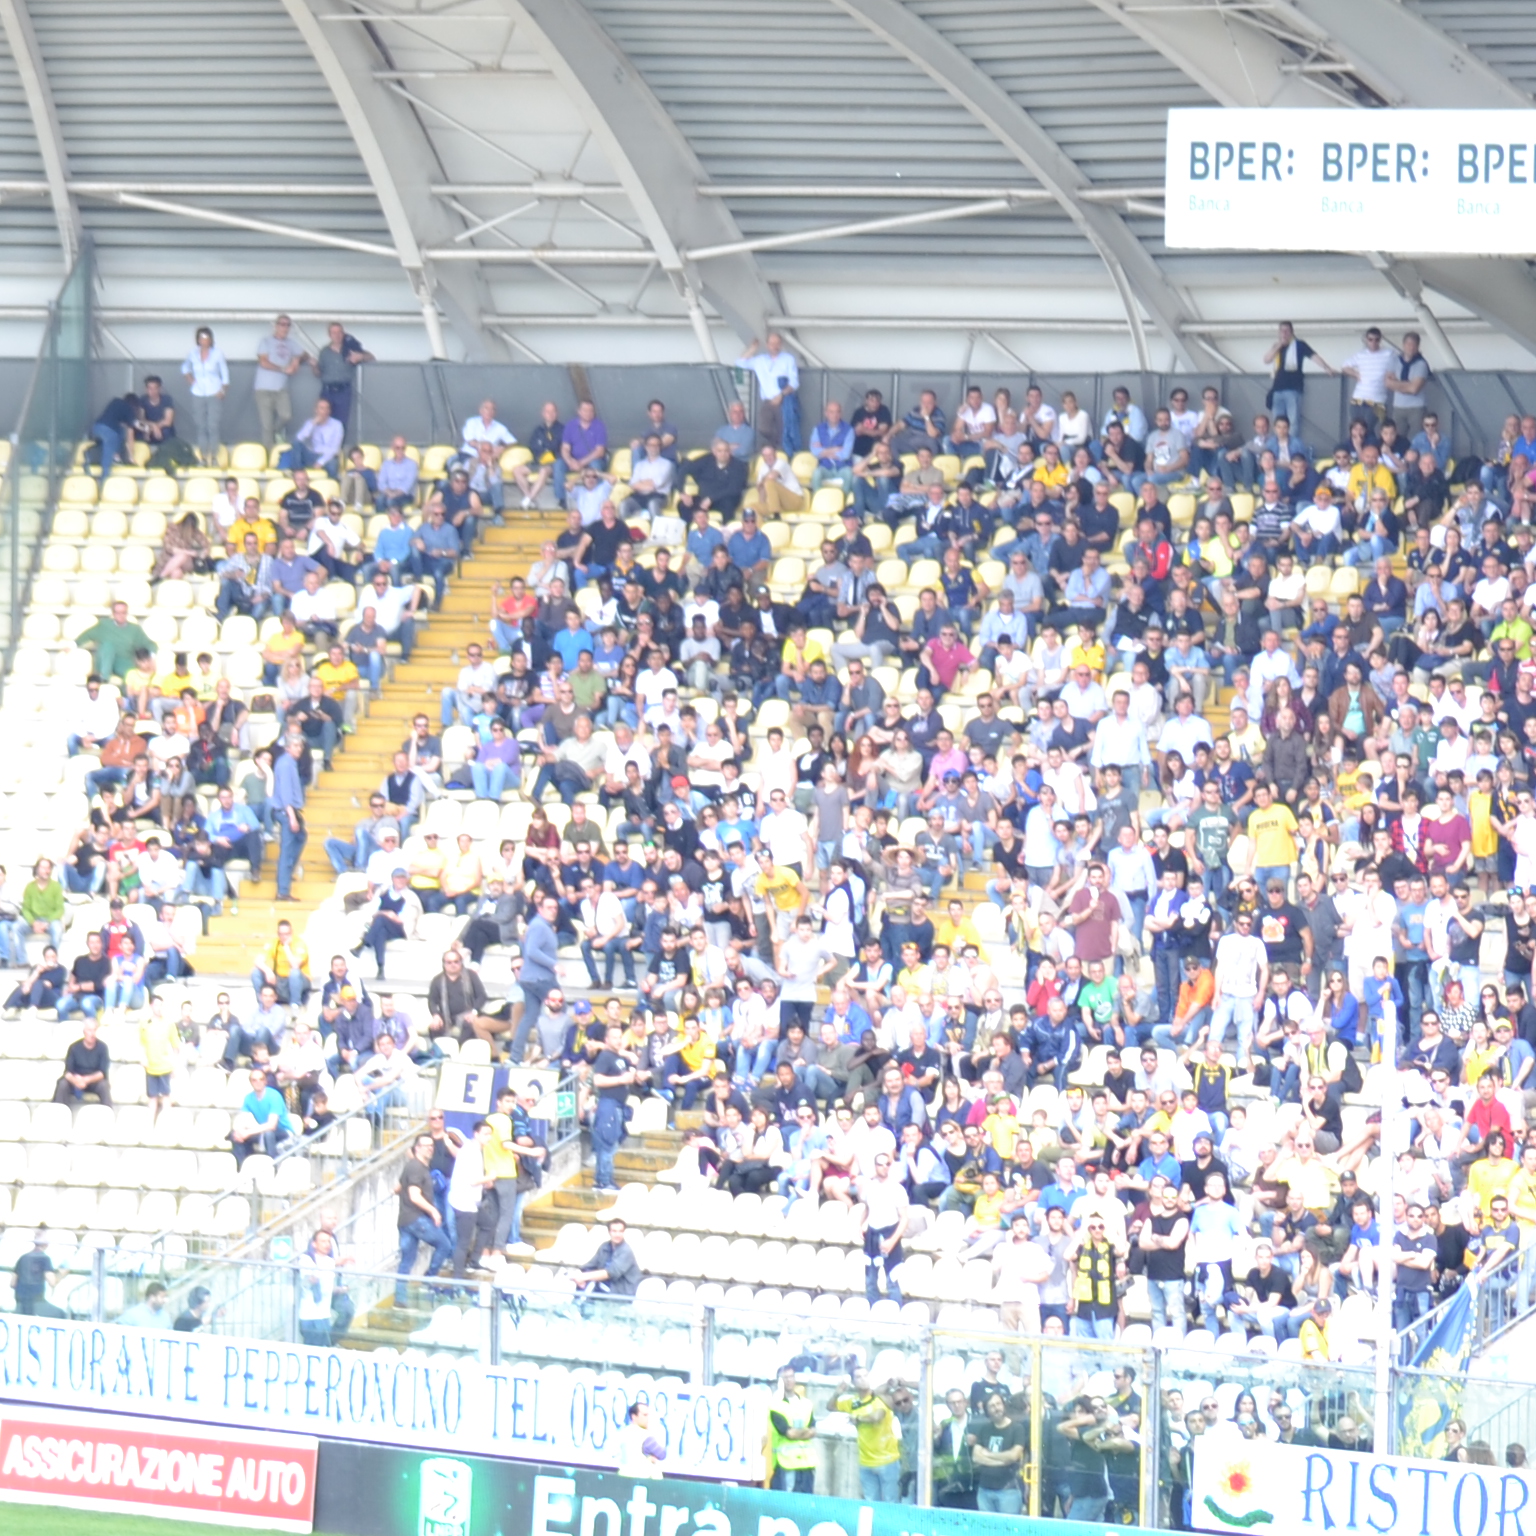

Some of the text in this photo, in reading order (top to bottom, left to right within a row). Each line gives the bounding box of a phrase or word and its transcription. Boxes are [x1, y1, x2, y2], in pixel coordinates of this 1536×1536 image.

[1190, 141, 1294, 181] BPER:
[1323, 142, 1429, 183] BPER:
[1322, 196, 1363, 213] Banca
[1457, 198, 1500, 214] Banca
[222, 1345, 463, 1435] PEPPERONCINO
[486, 1372, 557, 1446] TEL.
[1, 1434, 306, 1506] ASSICURAZIONE AUTO
